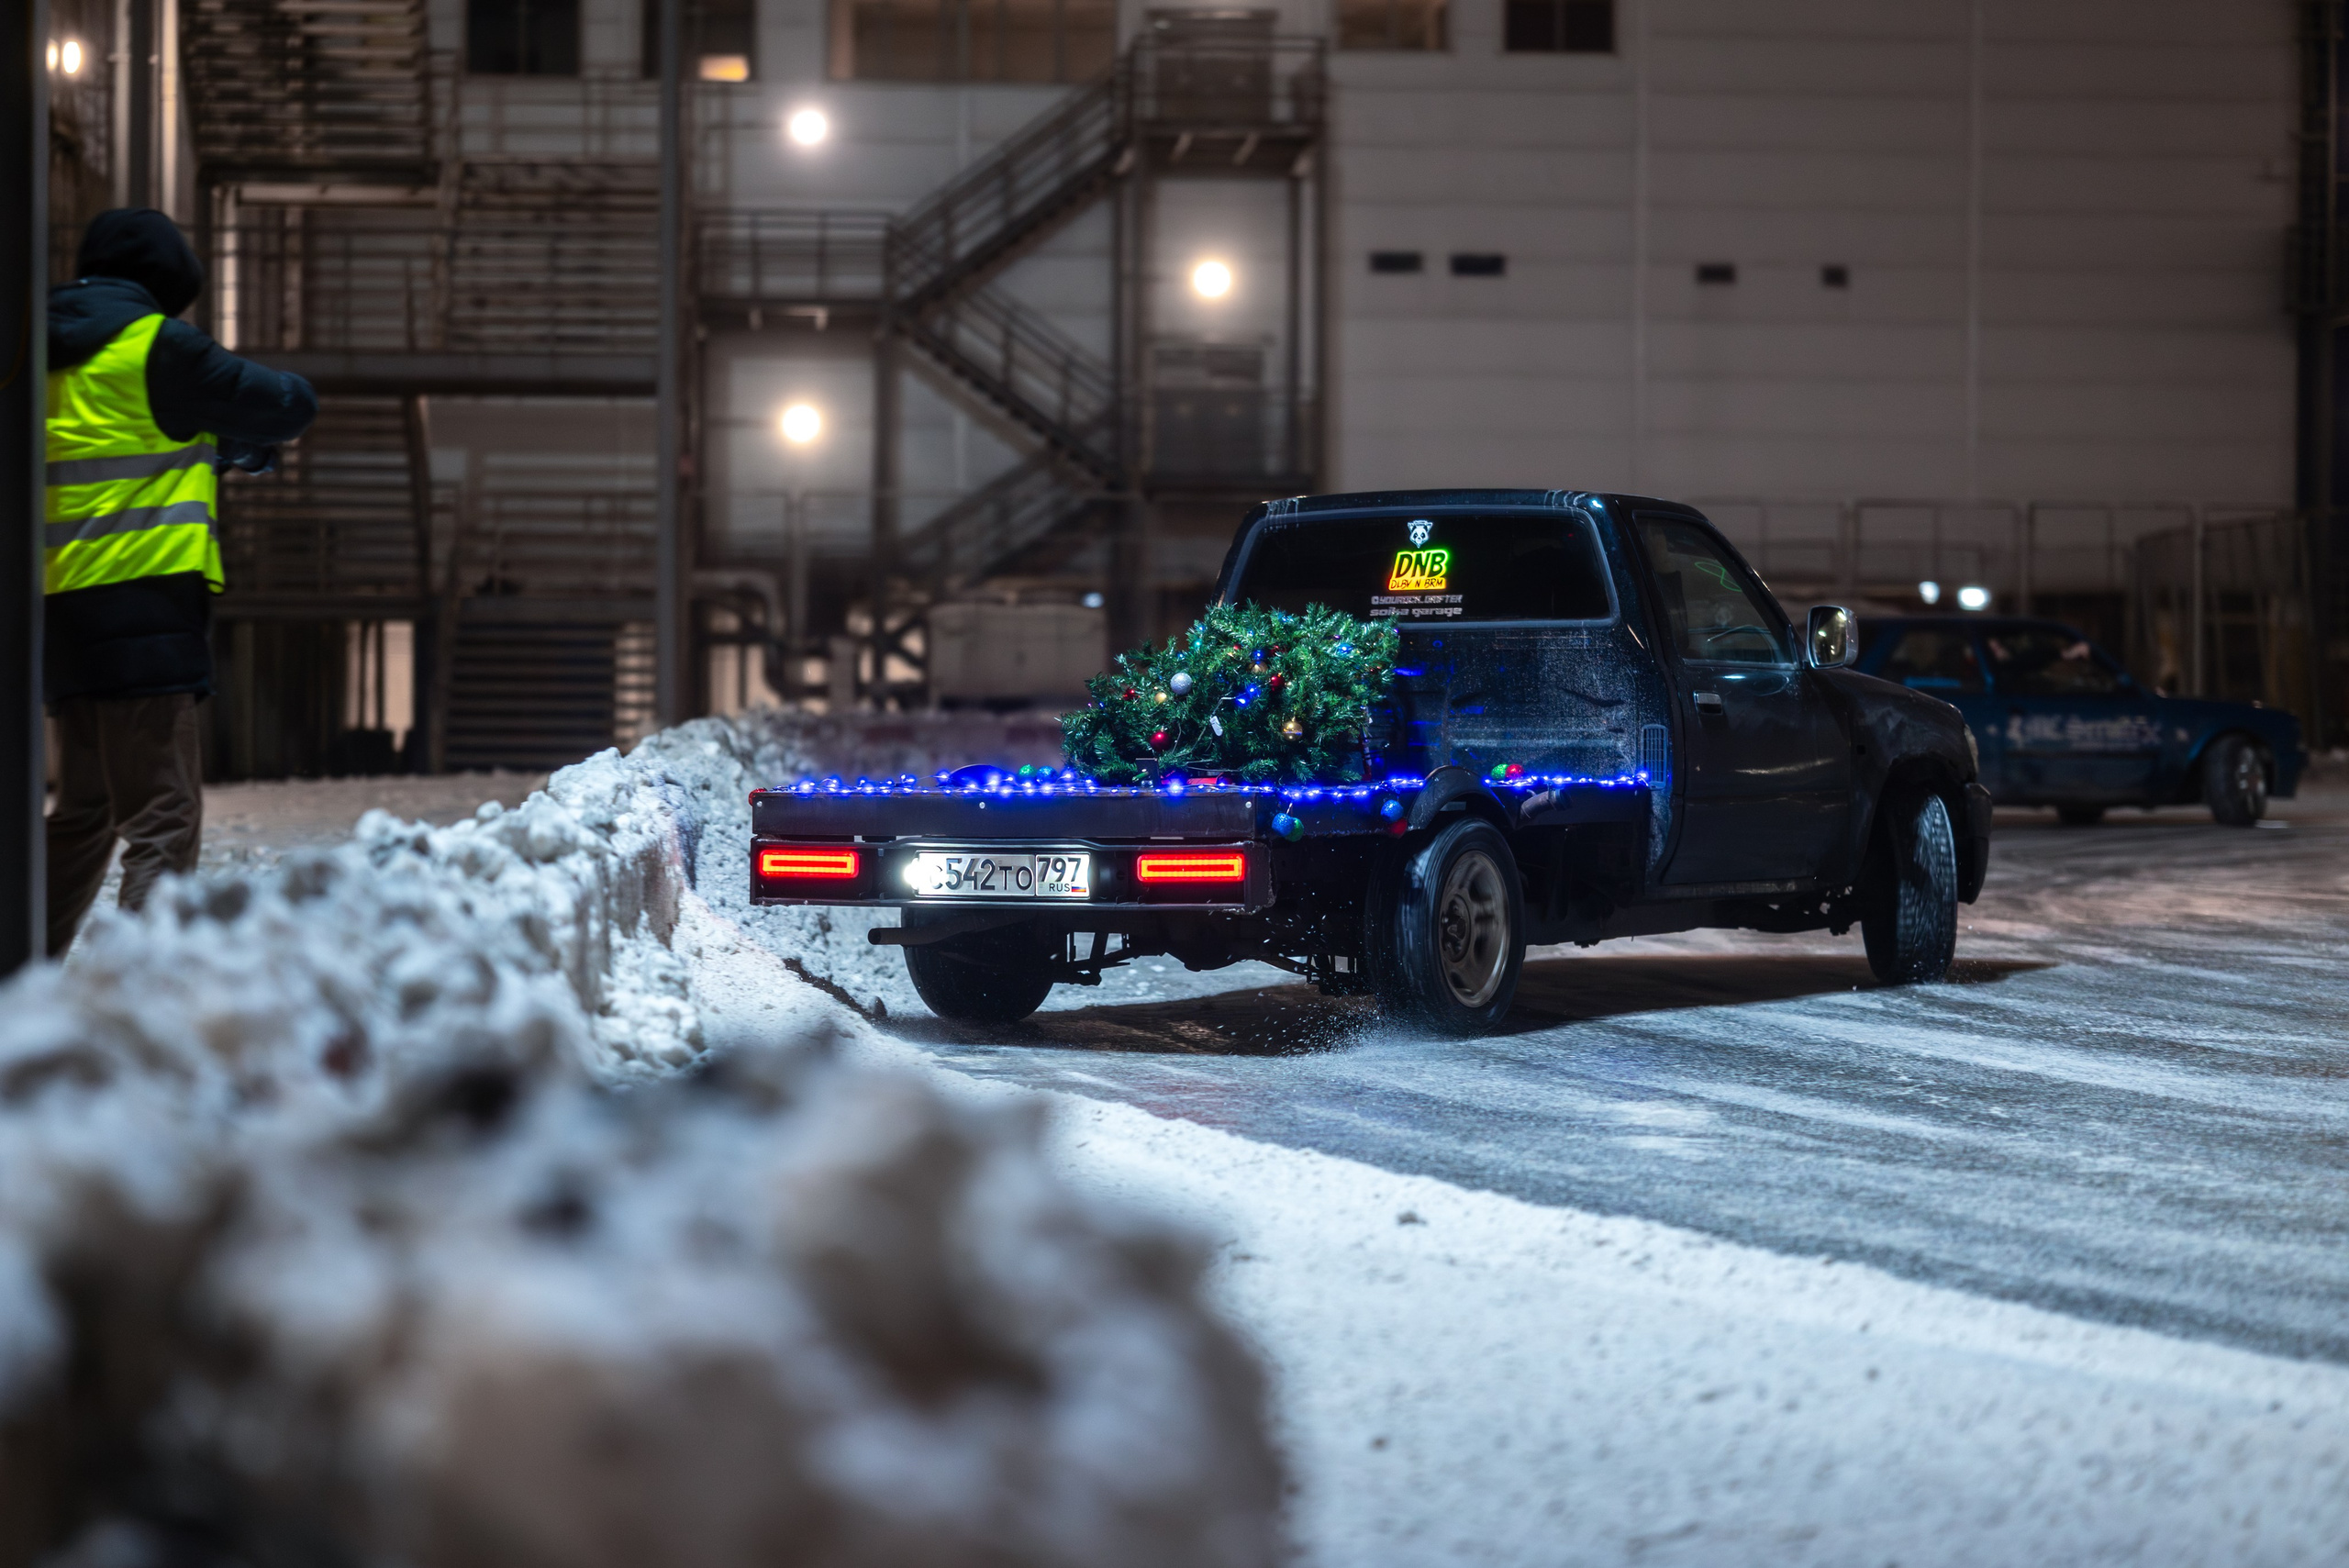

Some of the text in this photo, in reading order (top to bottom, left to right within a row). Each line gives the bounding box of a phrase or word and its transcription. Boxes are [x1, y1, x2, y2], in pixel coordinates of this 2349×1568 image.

[1395, 551, 1446, 579] DNB
[1414, 580, 1421, 588] N
[1412, 607, 1463, 617] garage
[1037, 858, 1082, 883] 797
[1049, 883, 1070, 893] RUS
